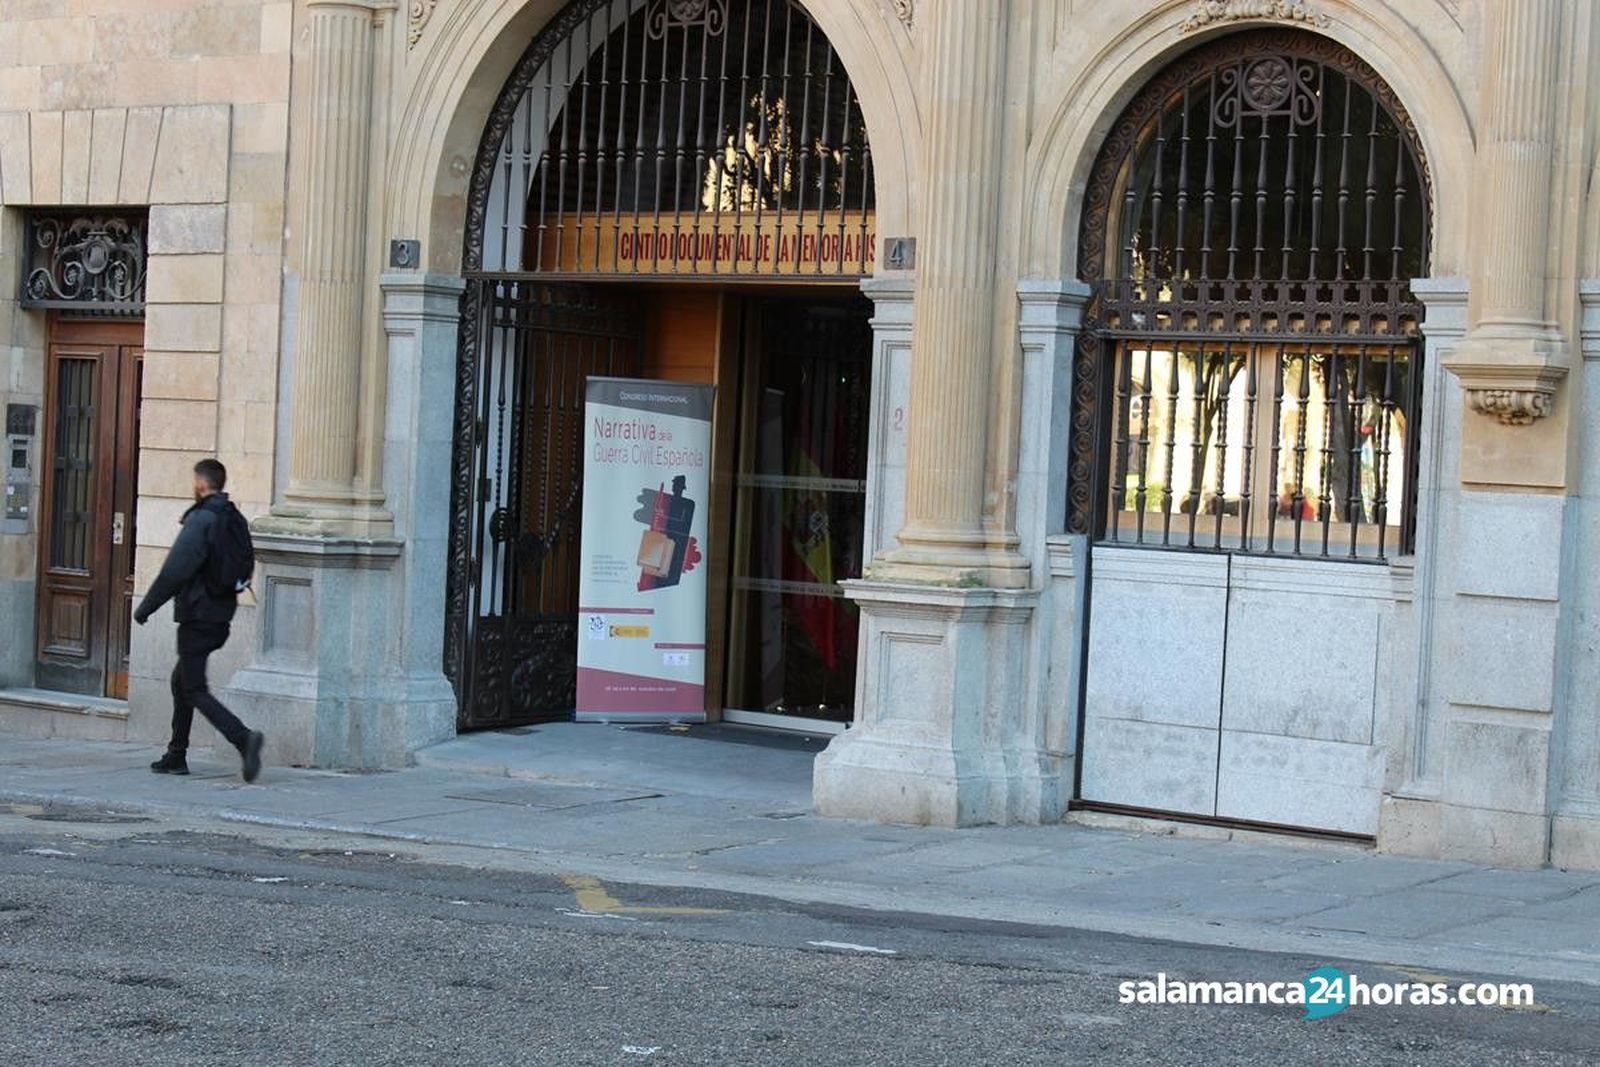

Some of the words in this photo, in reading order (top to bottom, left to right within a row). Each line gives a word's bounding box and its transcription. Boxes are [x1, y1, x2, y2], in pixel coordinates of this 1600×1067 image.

[396, 242, 409, 265] 3
[889, 239, 904, 267] 4
[594, 416, 656, 441] Narrativa
[894, 407, 903, 431] 2
[593, 442, 628, 464] Guerra
[631, 444, 654, 466] Civil
[656, 445, 704, 469] Española
